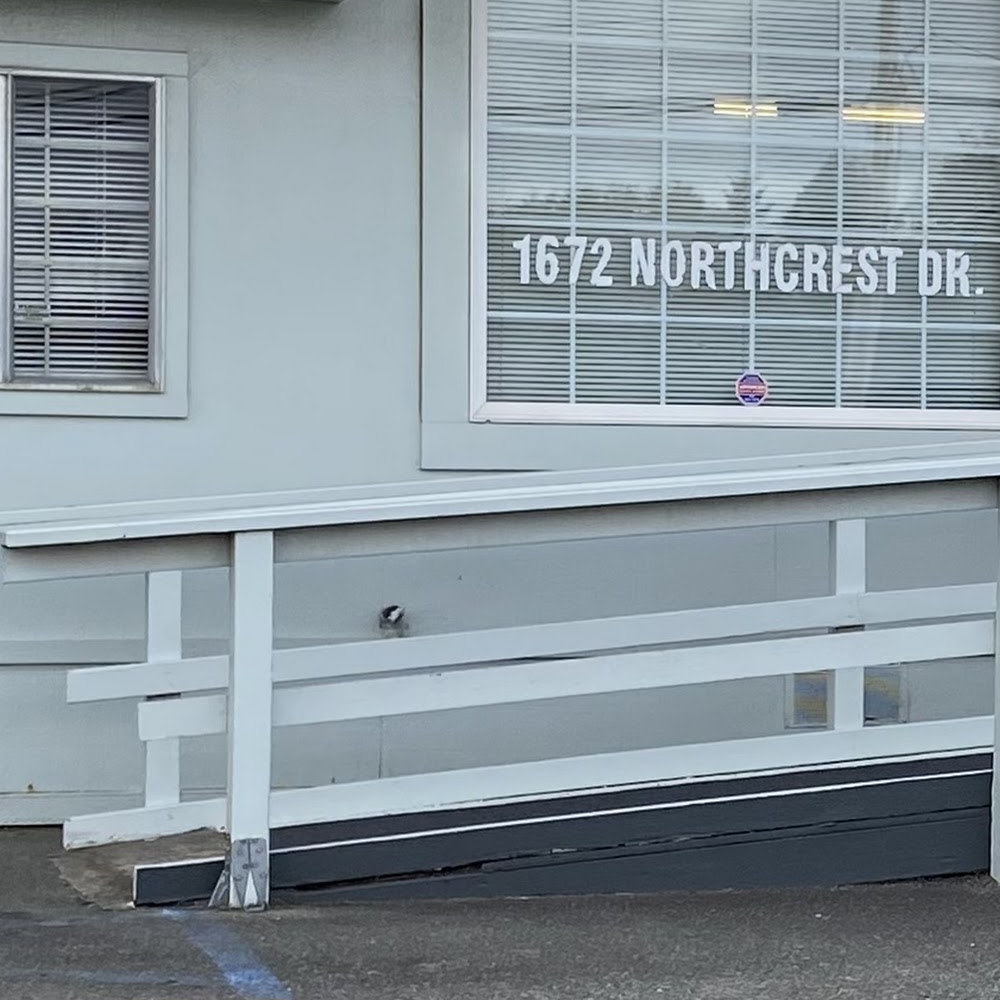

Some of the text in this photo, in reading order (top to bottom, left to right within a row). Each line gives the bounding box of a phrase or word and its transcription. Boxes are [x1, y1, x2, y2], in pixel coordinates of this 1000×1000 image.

[512, 234, 985, 297] 1672 NORTHCREST DR.
